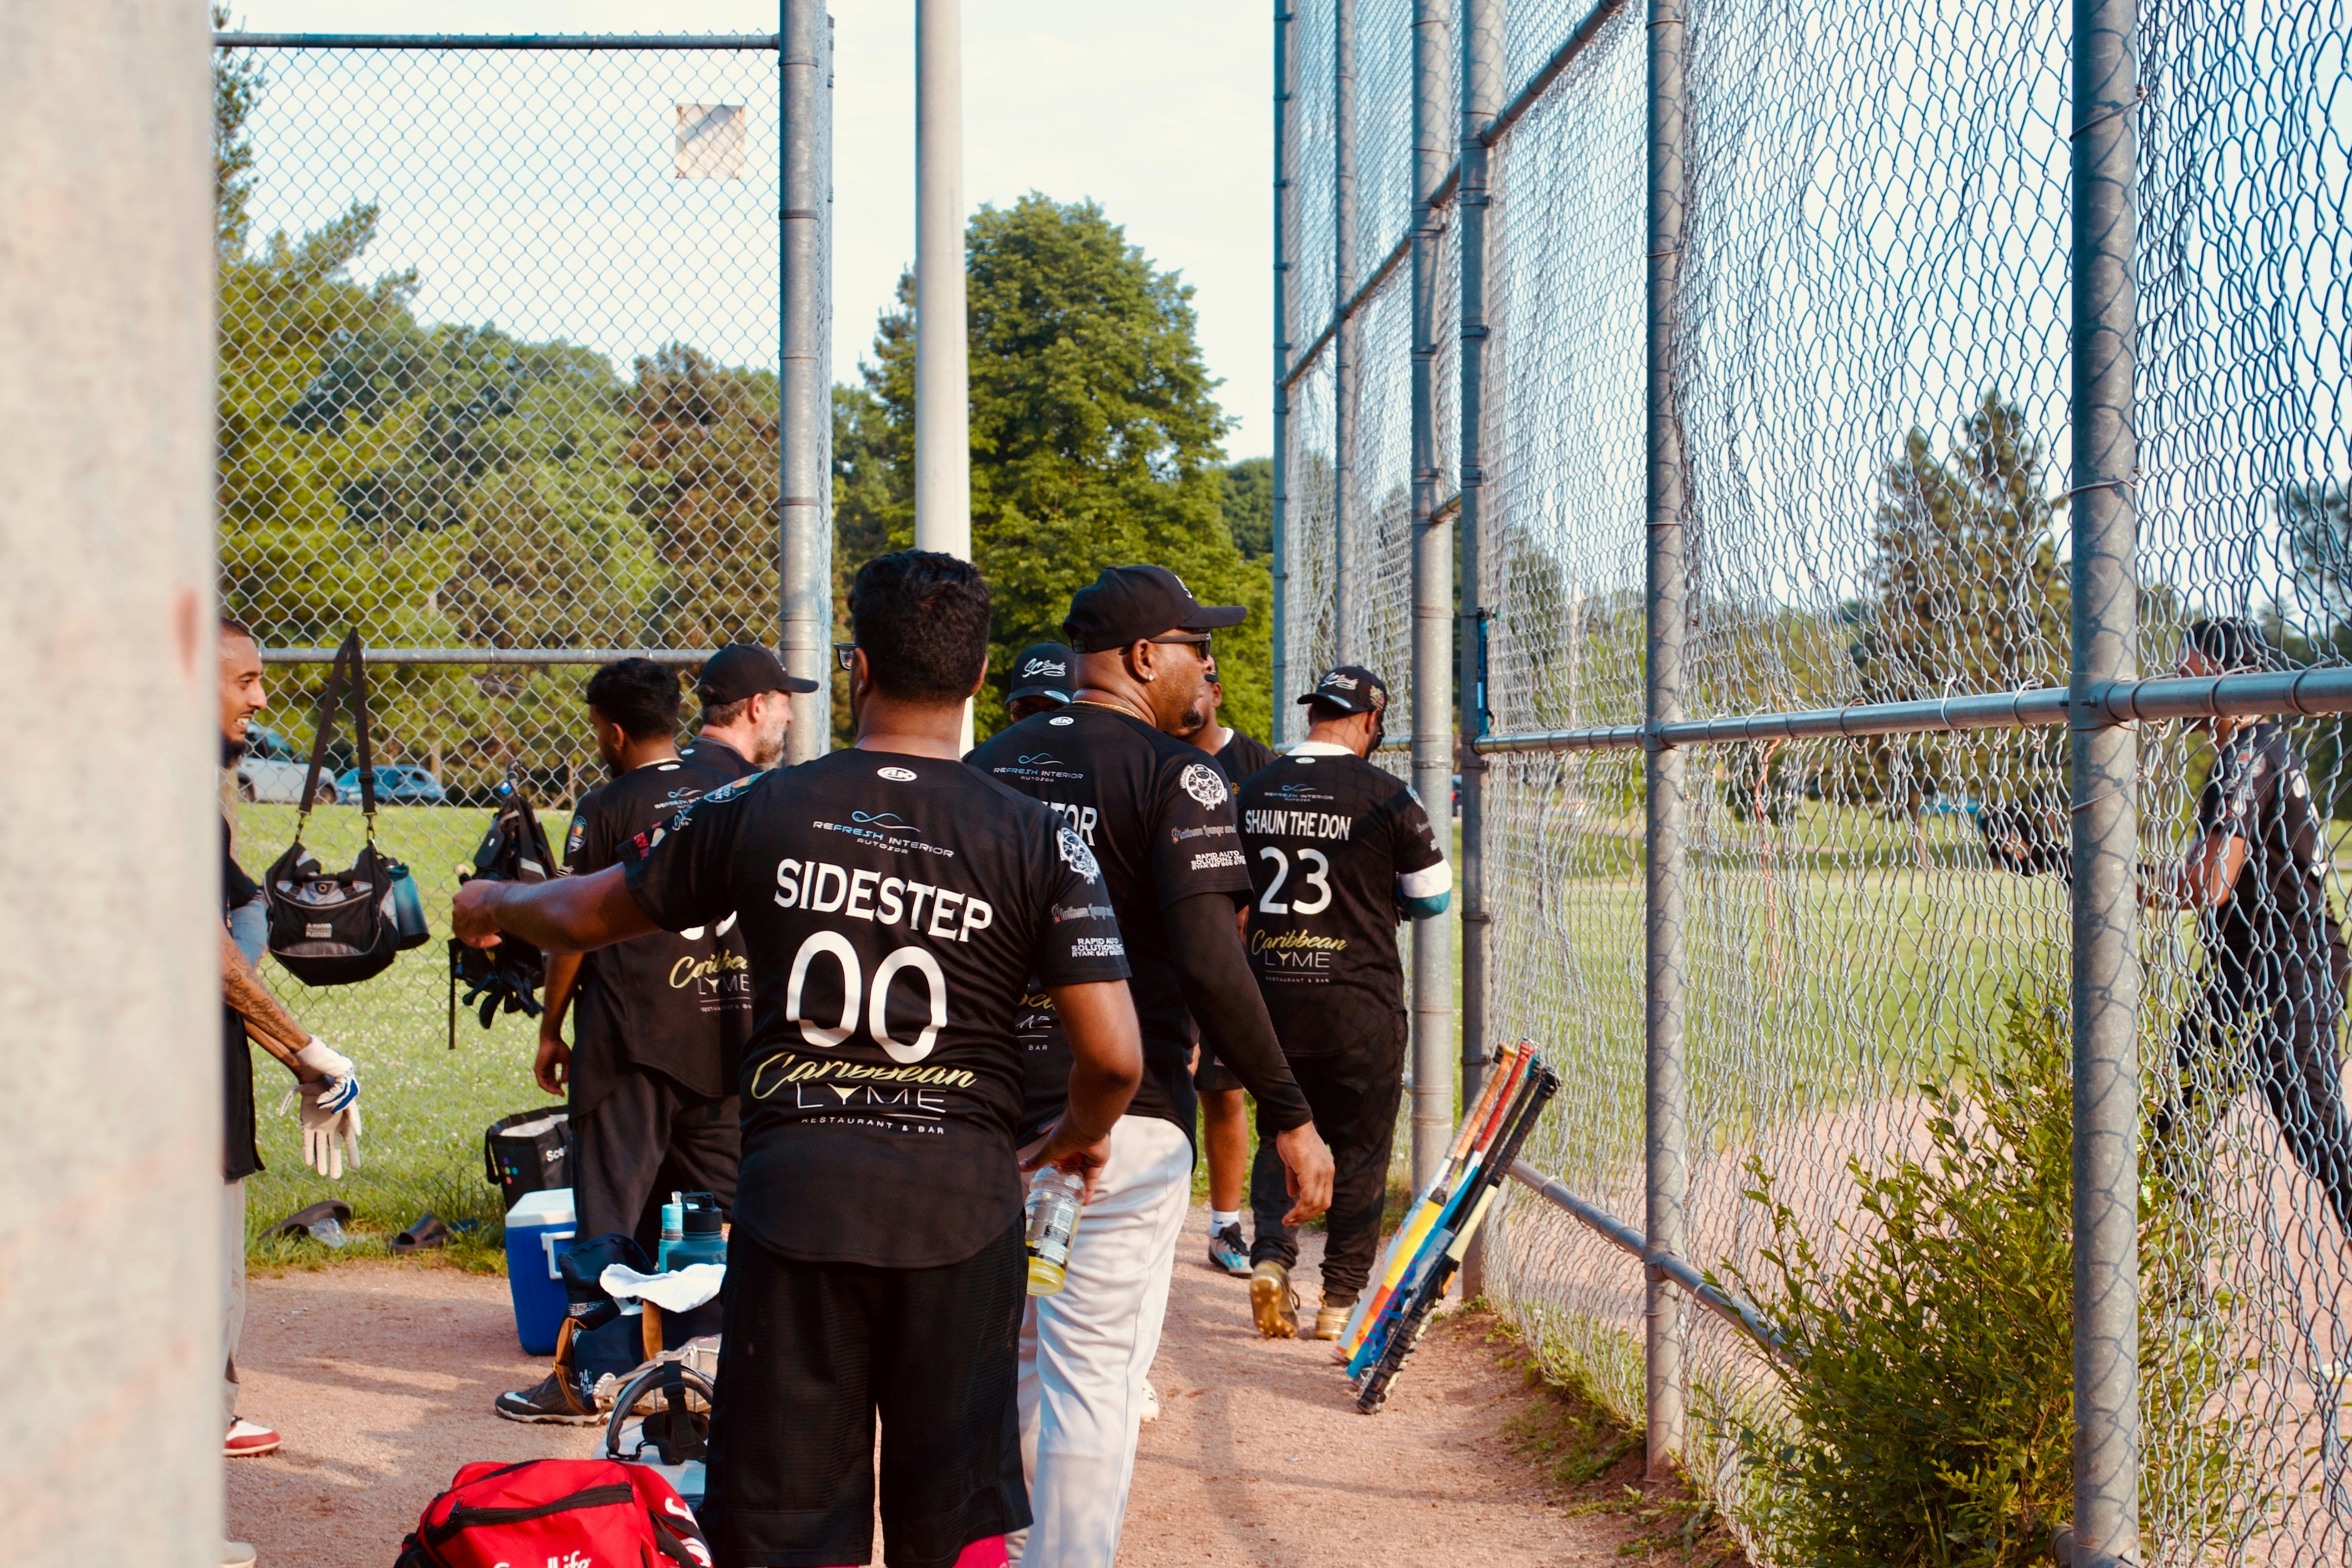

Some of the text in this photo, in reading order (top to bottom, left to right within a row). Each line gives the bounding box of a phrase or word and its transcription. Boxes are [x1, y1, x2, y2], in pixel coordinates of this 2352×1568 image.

[993, 767, 1084, 779] REFRESH INTERIOR
[813, 821, 954, 858] REFRESH INTERIOR
[1245, 810, 1352, 841] SHAUN THE DON
[856, 838, 909, 855] AUTOSPA
[1259, 846, 1332, 915] 23
[774, 859, 993, 943] SIDESTEP
[1077, 937, 1105, 945] RAPID
[1252, 929, 1347, 955] Caribbean
[1265, 950, 1331, 968] LYME
[787, 930, 947, 1064] 00
[796, 1082, 948, 1113] LYME
[801, 1116, 893, 1130] RESTAURANT
[918, 1125, 944, 1135] BAR
